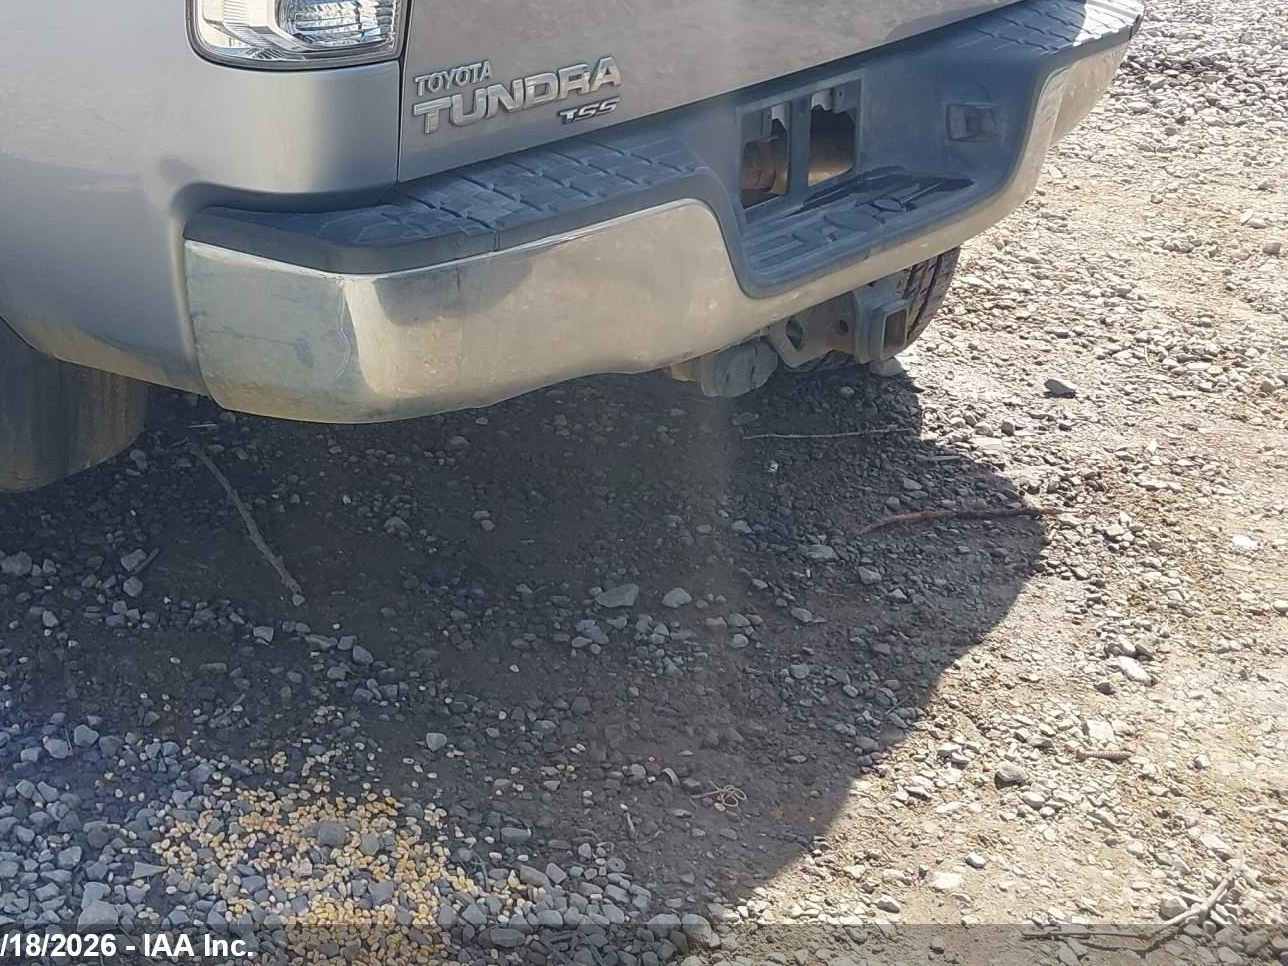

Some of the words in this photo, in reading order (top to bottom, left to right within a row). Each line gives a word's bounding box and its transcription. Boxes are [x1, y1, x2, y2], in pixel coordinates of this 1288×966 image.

[413, 56, 622, 134] TUNDRA
[414, 60, 494, 96] TOYOTA
[559, 97, 621, 124] TSS
